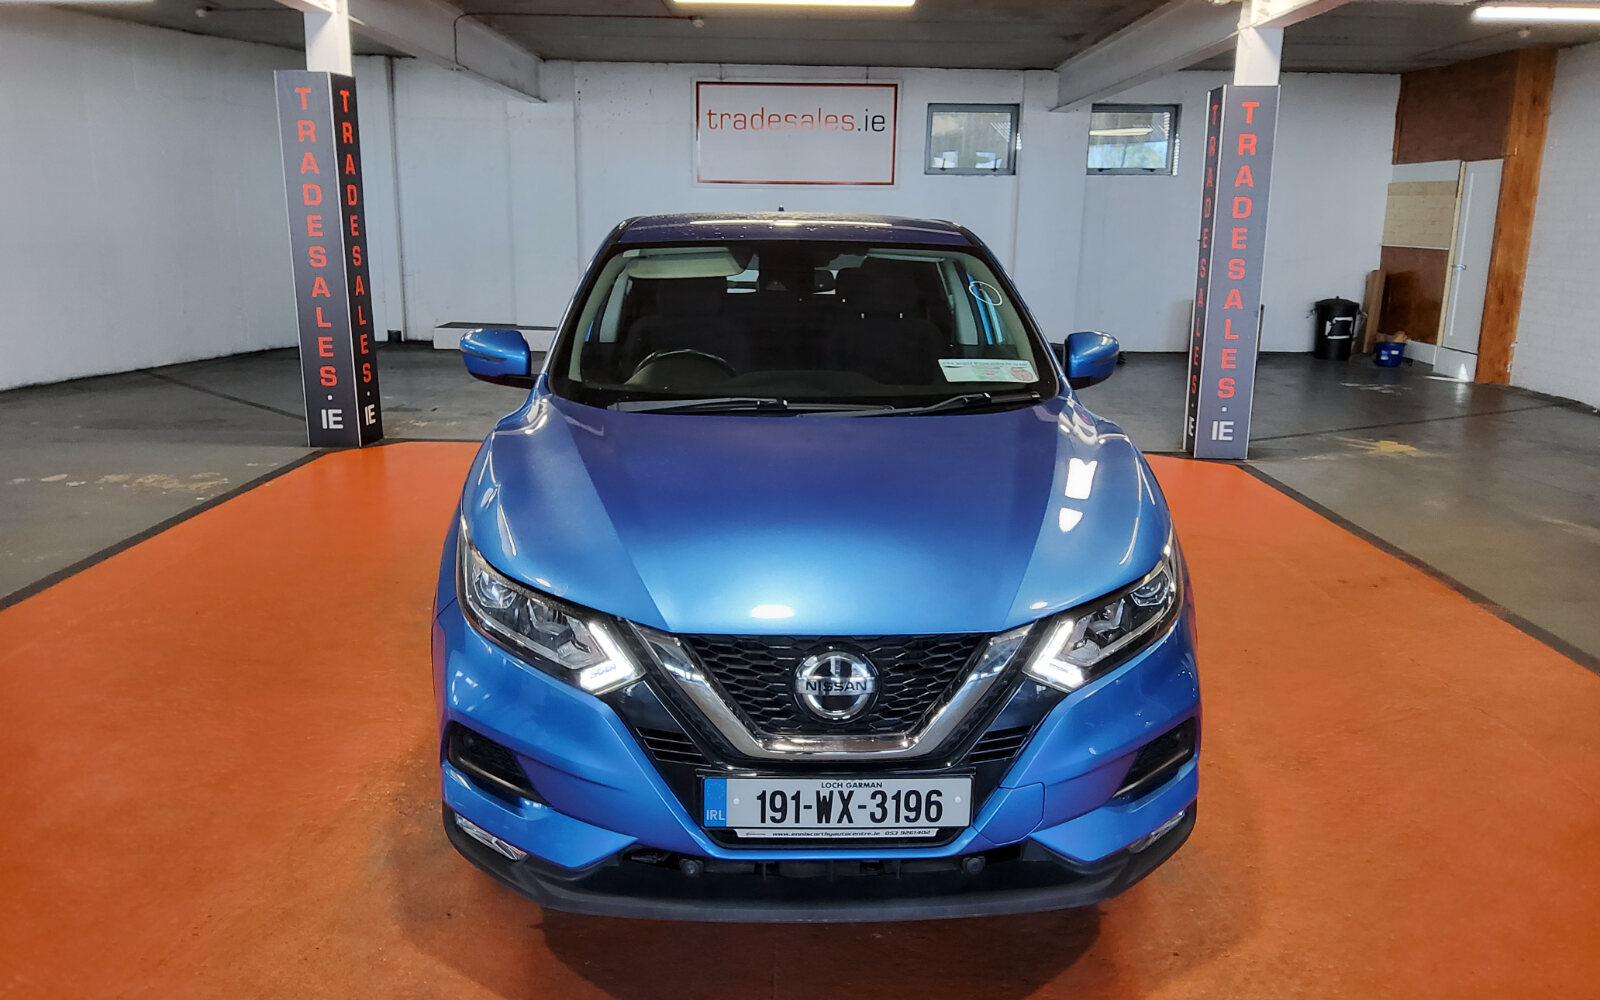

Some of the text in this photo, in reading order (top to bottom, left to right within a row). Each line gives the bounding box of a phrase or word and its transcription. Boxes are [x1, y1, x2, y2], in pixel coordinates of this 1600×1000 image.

[707, 106, 886, 132] tradesales.ie
[805, 681, 867, 692] NISSAN
[706, 809, 726, 821] IRL
[756, 789, 943, 824] 191-WX-3196
